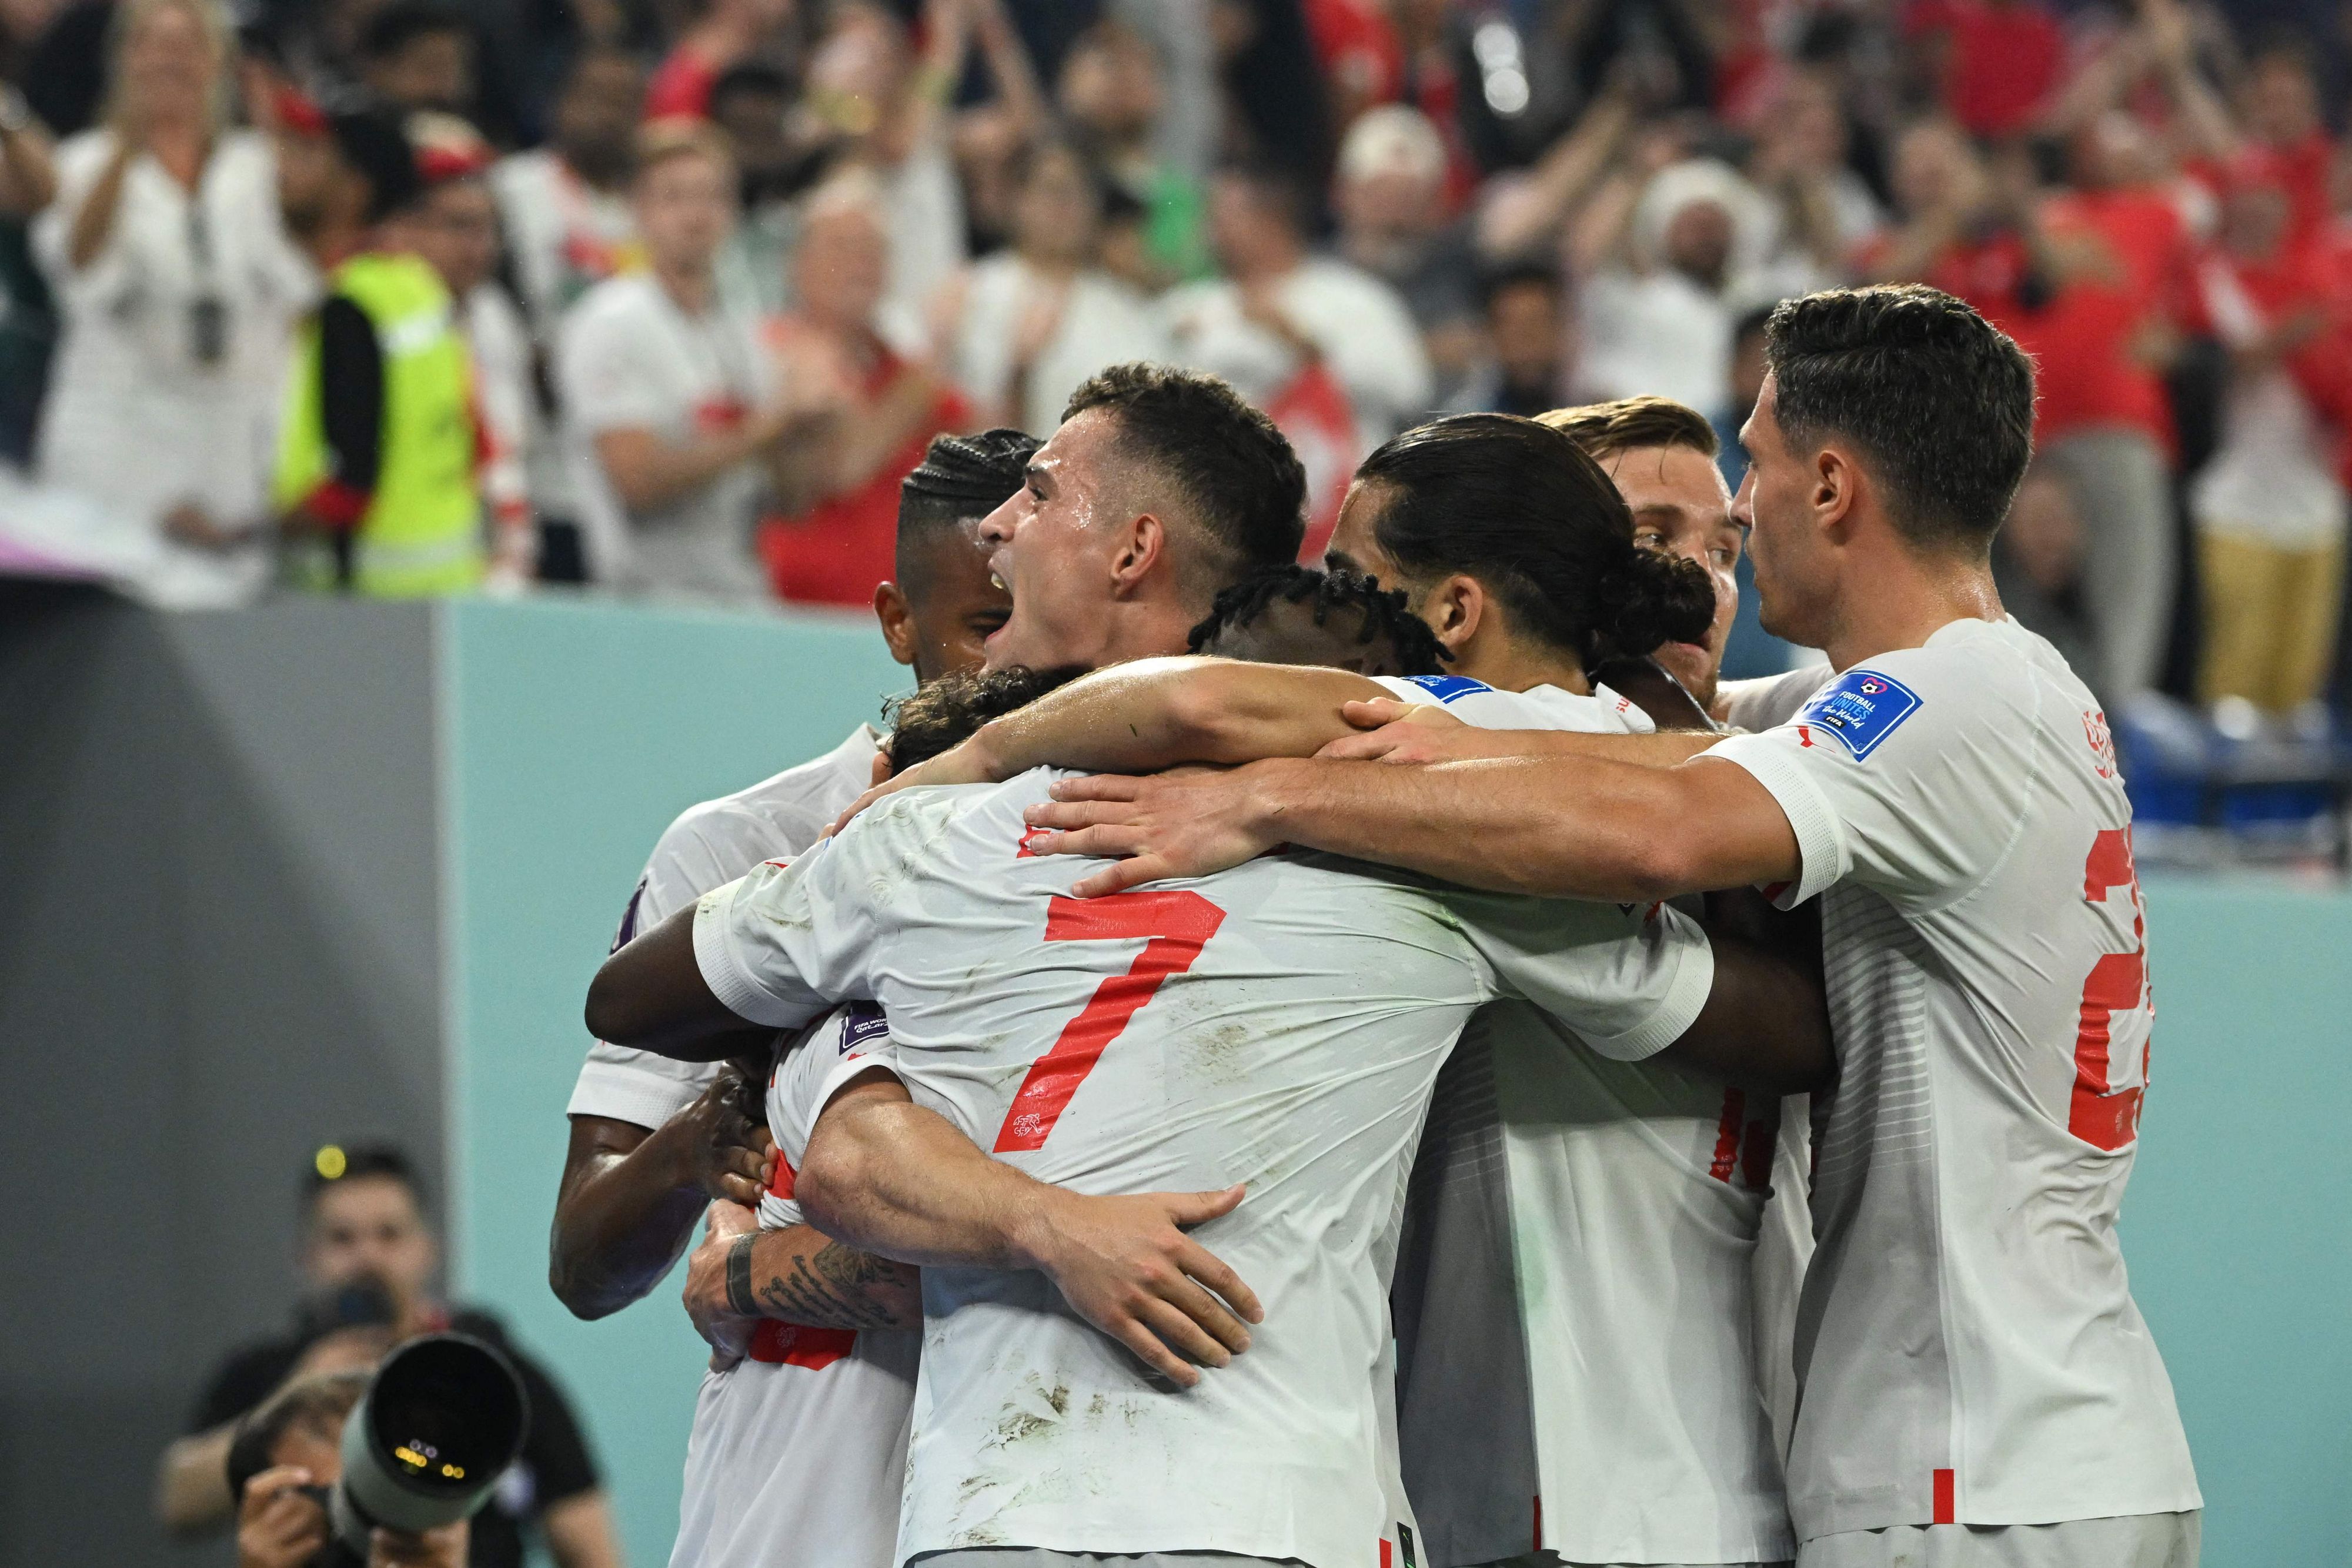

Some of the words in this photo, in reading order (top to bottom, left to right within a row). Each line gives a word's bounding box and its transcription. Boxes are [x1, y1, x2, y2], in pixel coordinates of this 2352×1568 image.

[1831, 697, 1871, 720] UNITES
[1838, 691, 1876, 713] FOOTBALL
[1822, 705, 1837, 713] the
[1836, 708, 1865, 729] World
[1826, 716, 1842, 727] FIFA
[854, 1022, 869, 1030] FIFA
[992, 890, 1228, 1153] 7
